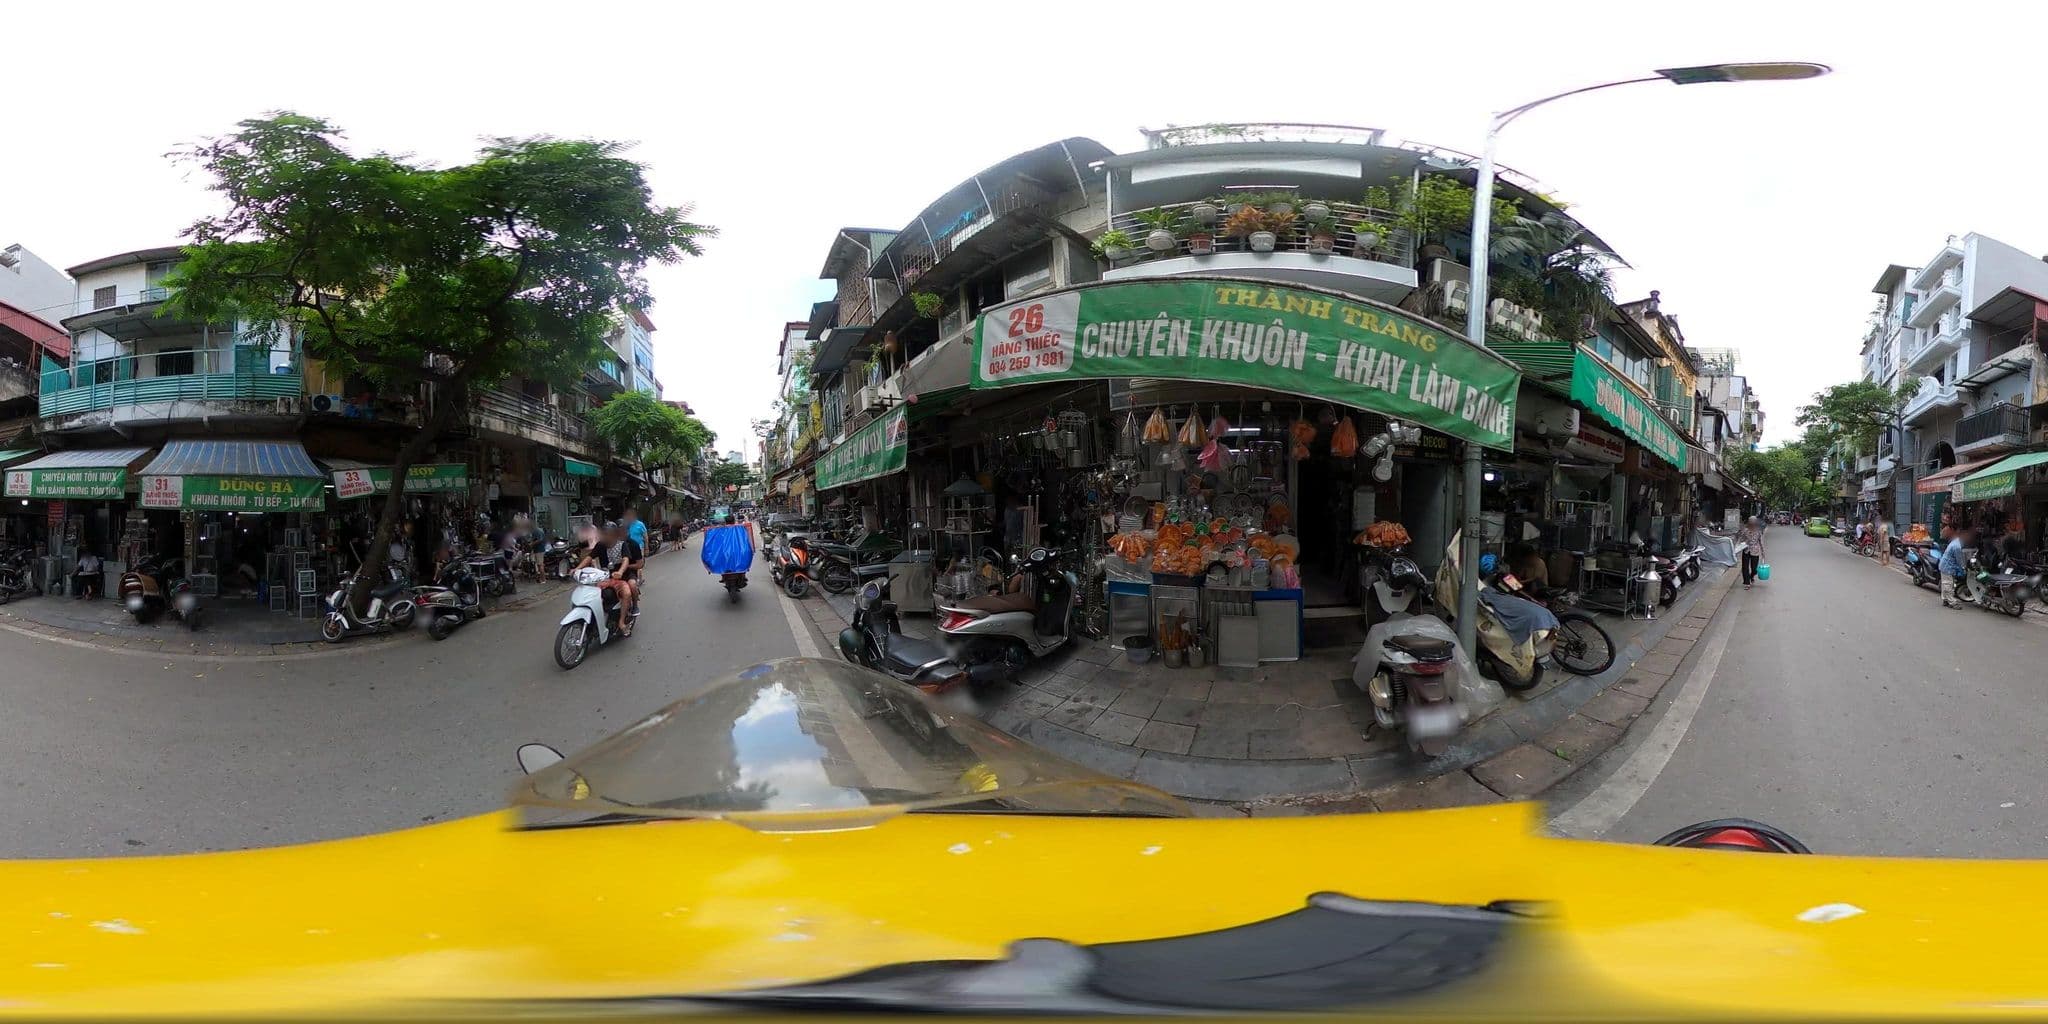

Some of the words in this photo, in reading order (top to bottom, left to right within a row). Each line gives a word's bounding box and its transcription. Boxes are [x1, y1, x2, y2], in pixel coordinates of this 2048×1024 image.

[1008, 303, 1045, 338] 26
[1215, 287, 1332, 320] THÀNH
[1341, 306, 1438, 353] TRANG
[992, 341, 1022, 358] HÀNG
[1025, 330, 1060, 352] THIẾC
[989, 361, 1006, 375] 034
[1009, 356, 1031, 371] 259
[1036, 350, 1064, 367] 1981
[1081, 311, 1192, 359] CHUYÊN
[1199, 318, 1309, 371] KHUÔN
[1334, 339, 1407, 394] KHAY
[1409, 362, 1461, 415] LÀM
[1462, 385, 1510, 436] BÁNH
[155, 478, 168, 491] 31
[345, 472, 360, 482] 33
[191, 494, 219, 506] KHUNG
[221, 493, 246, 507] NHÔM
[266, 493, 282, 507] BẾP
